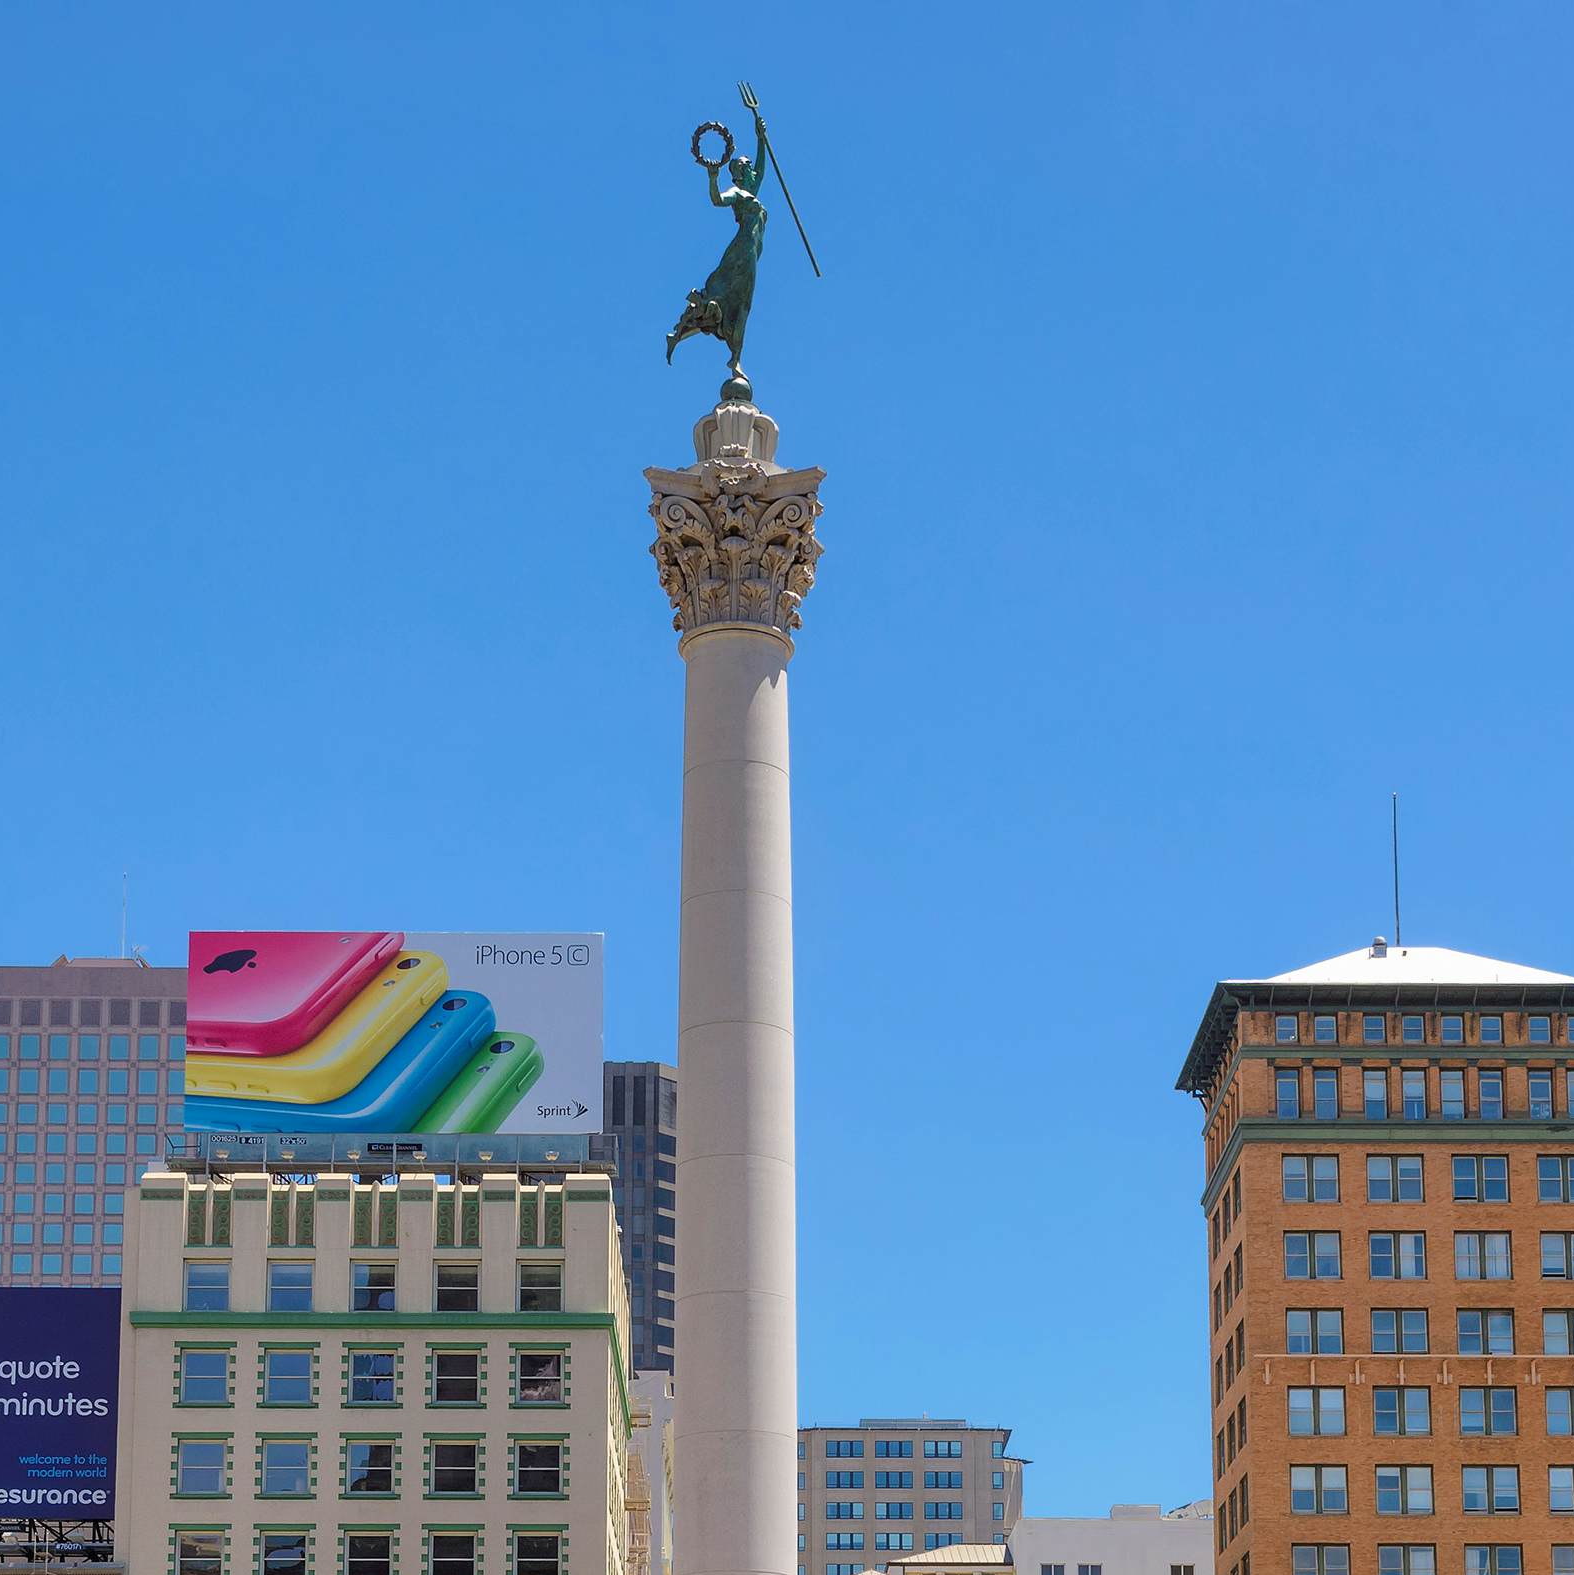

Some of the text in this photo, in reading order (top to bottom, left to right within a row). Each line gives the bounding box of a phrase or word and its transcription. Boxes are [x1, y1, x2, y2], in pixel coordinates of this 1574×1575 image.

[476, 944, 546, 965] iPhone
[550, 945, 563, 966] 5
[537, 1105, 572, 1119] Sprint
[18, 1453, 107, 1465] welcome to the
[27, 1466, 107, 1478] modern world
